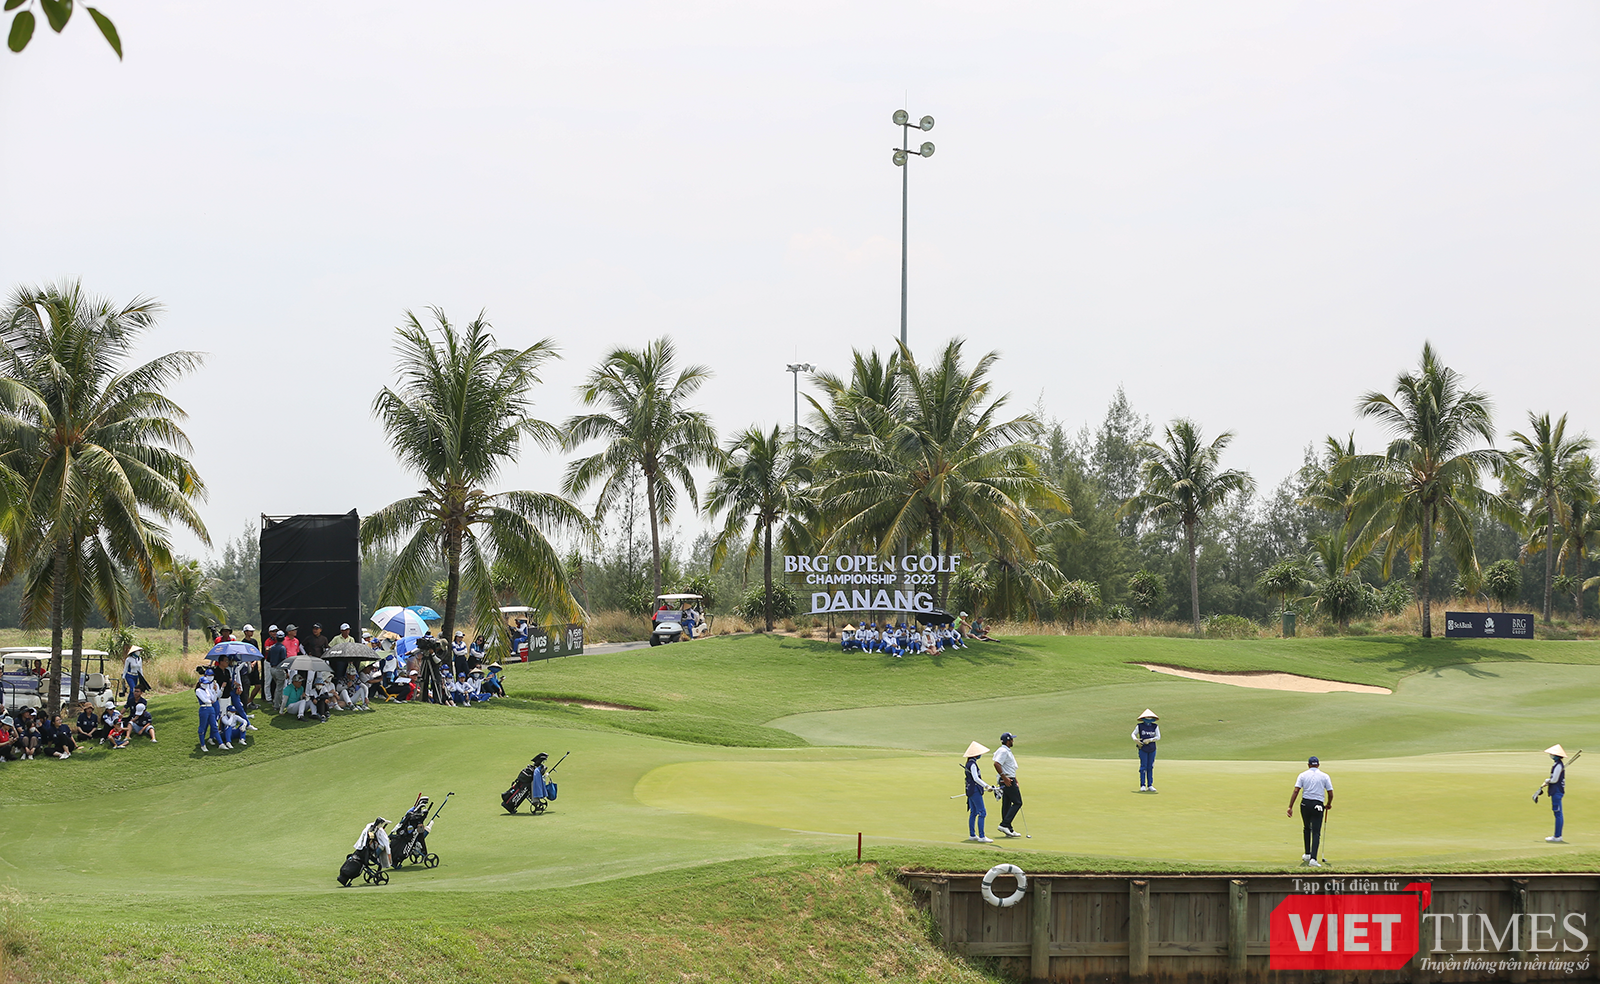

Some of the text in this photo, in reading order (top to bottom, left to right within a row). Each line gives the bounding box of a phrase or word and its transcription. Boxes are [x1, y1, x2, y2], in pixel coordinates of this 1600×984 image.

[784, 555, 961, 573] BRG OPEN GOLF
[806, 573, 936, 585] CHAMPIONSHIP 2023
[811, 589, 934, 613] DANANG
[1512, 618, 1526, 628] BRG
